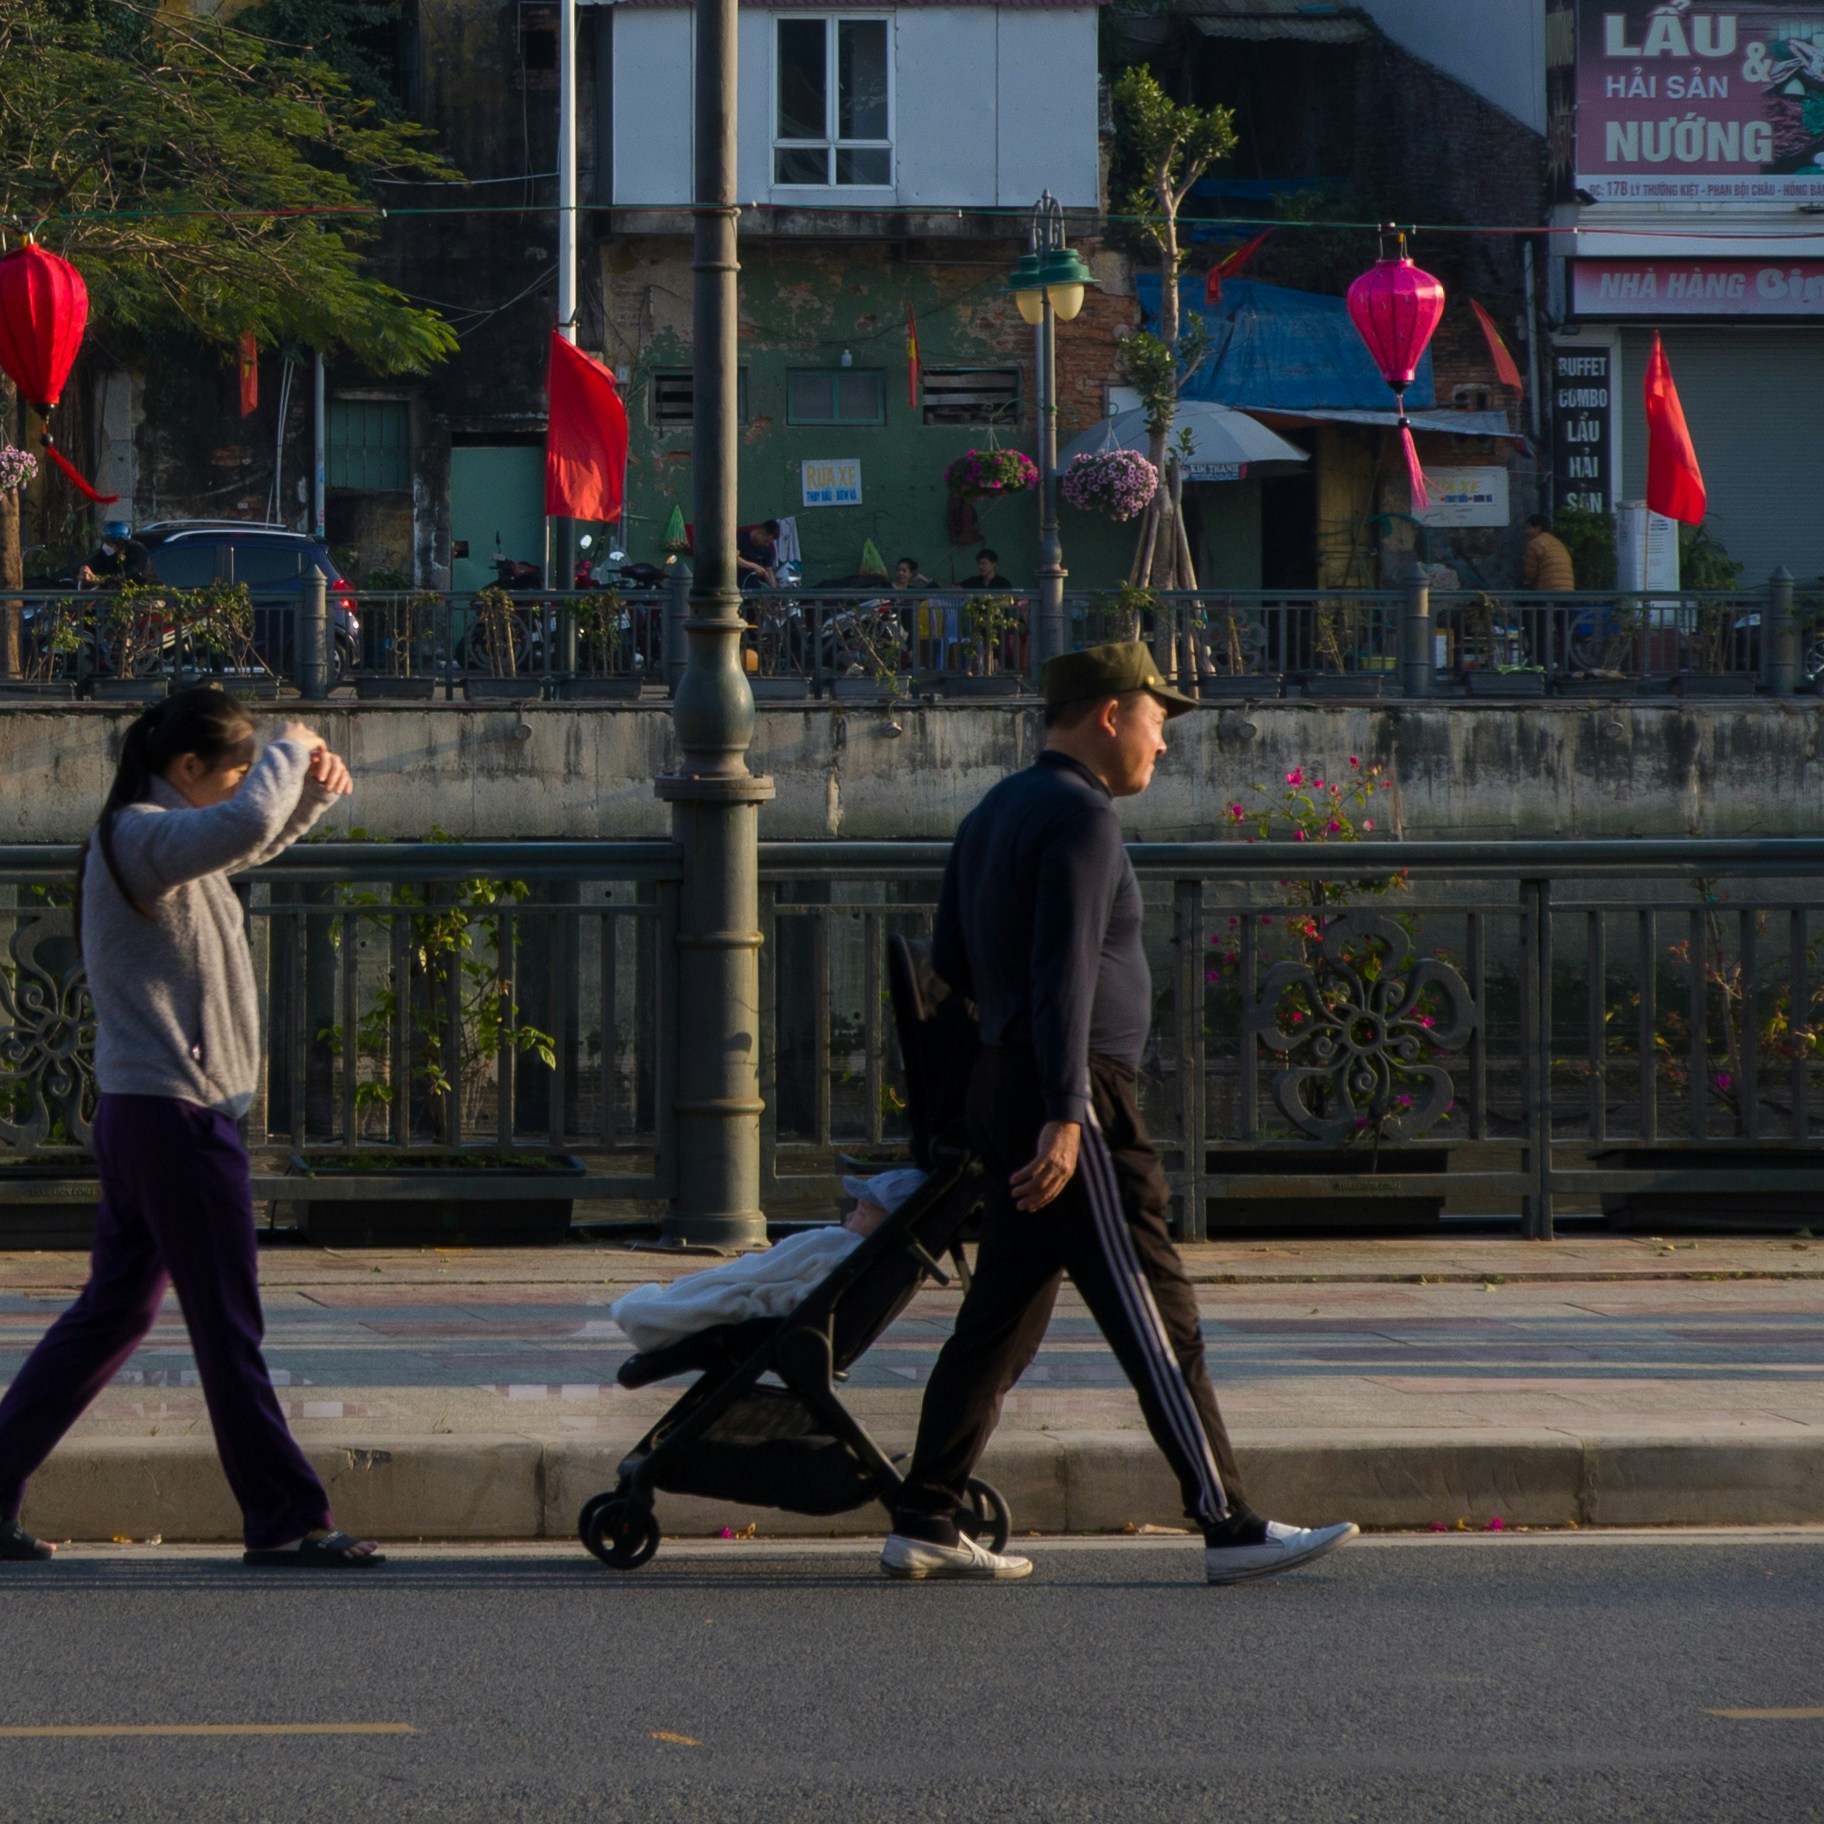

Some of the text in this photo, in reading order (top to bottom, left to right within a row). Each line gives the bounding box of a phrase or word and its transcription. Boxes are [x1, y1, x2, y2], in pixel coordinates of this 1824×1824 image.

[1743, 42, 1773, 83] &
[1606, 66, 1728, 99] HẢI SẢN
[1606, 112, 1773, 162] NƯỚNG
[1607, 181, 1627, 196] 17B
[1707, 184, 1732, 196] PHAN
[1603, 267, 1658, 299] NHÀ
[1666, 267, 1746, 299] HÀNG
[1558, 357, 1606, 377] BUFFET
[1559, 388, 1608, 408] COMBO
[1567, 411, 1600, 442] LẨU
